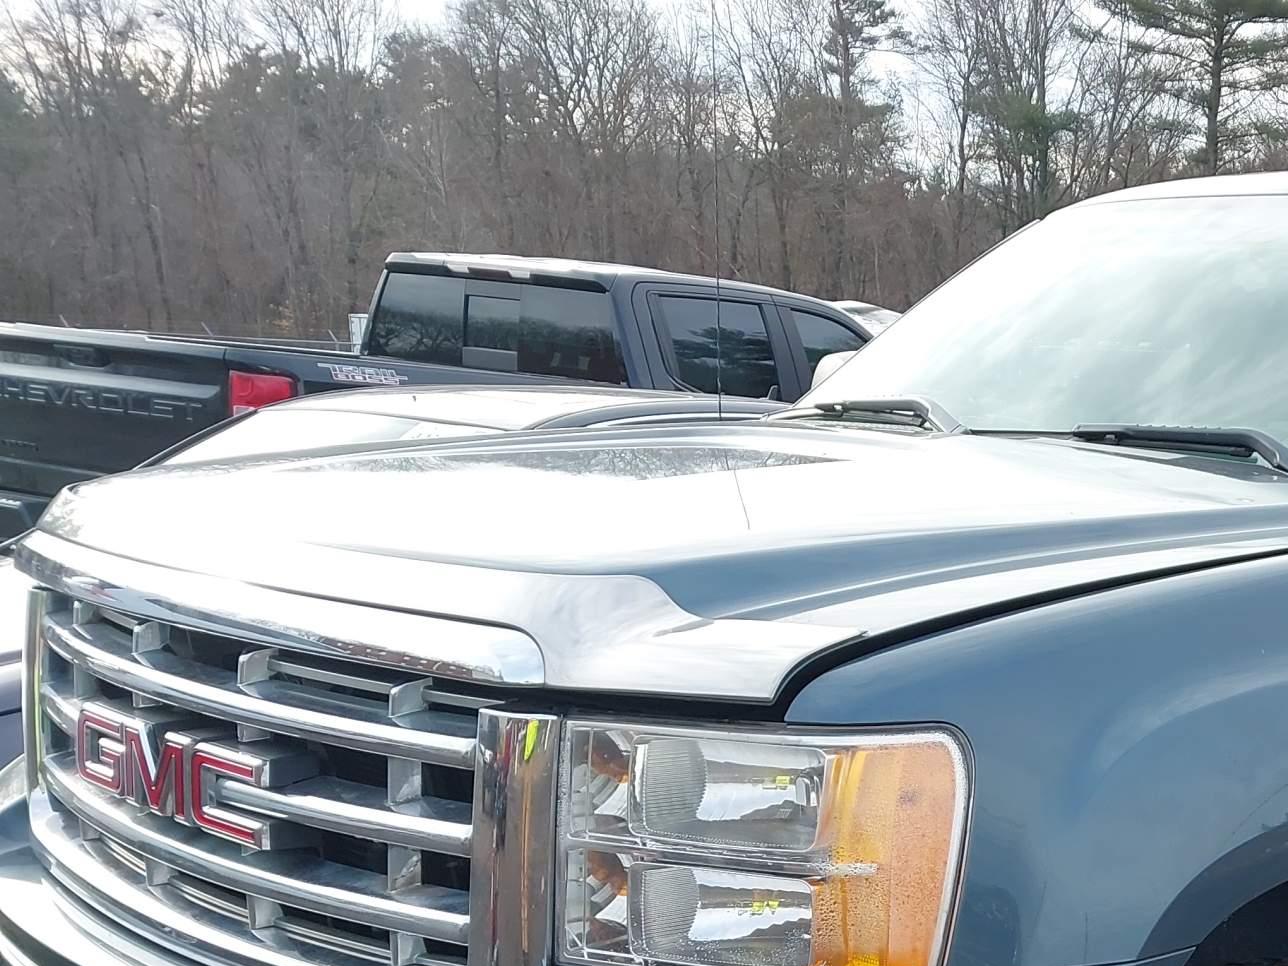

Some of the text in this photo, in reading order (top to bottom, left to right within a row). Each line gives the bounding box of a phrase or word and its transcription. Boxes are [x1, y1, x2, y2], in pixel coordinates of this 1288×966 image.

[317, 363, 408, 380] TRAIL
[331, 371, 400, 385] BOSS
[0, 377, 202, 421] HEVROLET
[77, 704, 269, 850] GMC
